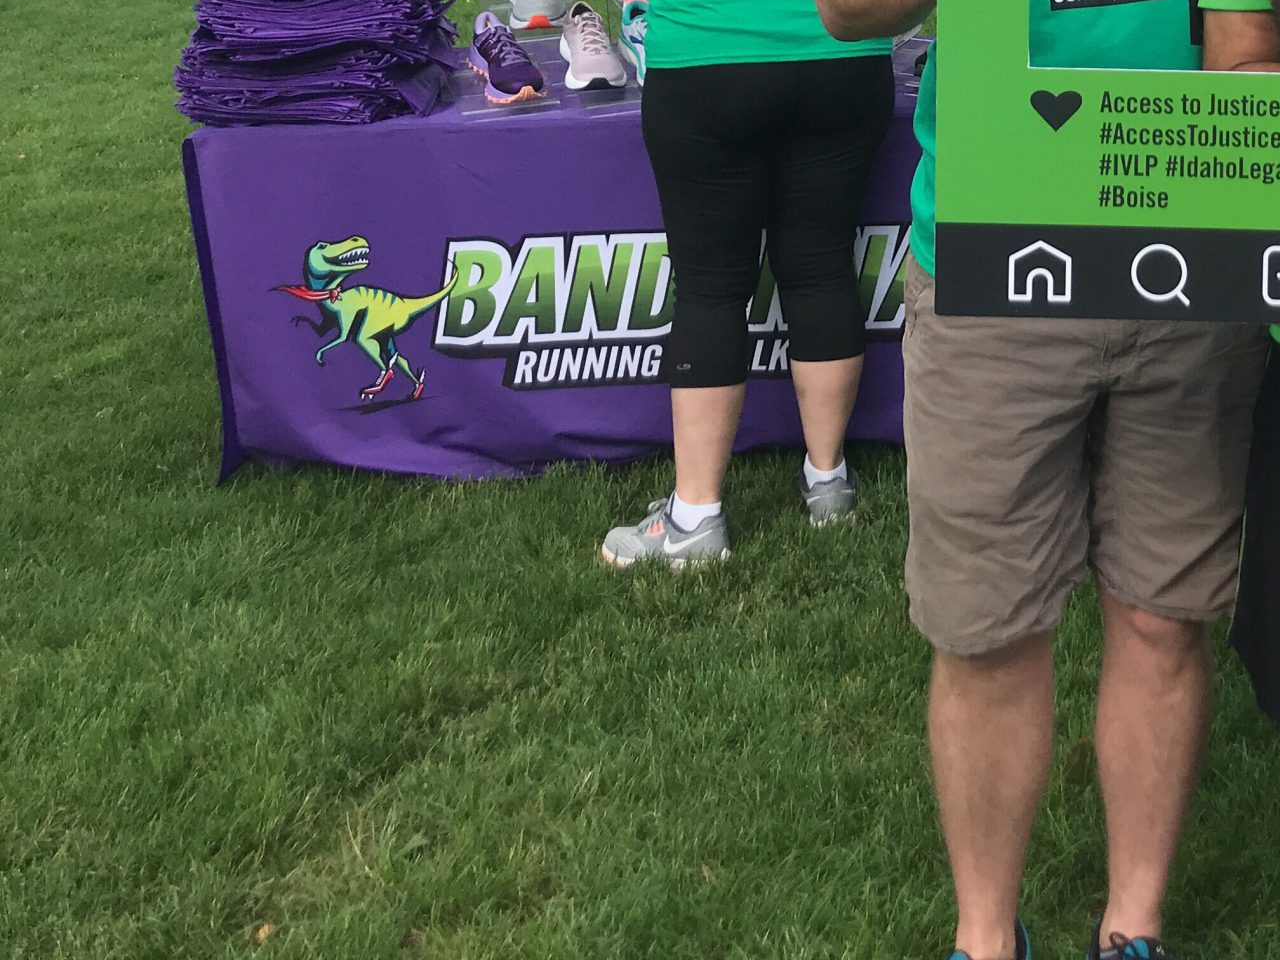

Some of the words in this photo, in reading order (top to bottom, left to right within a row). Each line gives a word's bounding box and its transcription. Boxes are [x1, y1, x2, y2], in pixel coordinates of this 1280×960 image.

[1100, 91, 1174, 115] Access
[1182, 94, 1201, 116] to
[1208, 93, 1280, 118] Justice
[1099, 154, 1158, 177] #IVLP
[1099, 185, 1169, 208] #Boise
[514, 344, 663, 385] RUNNING
